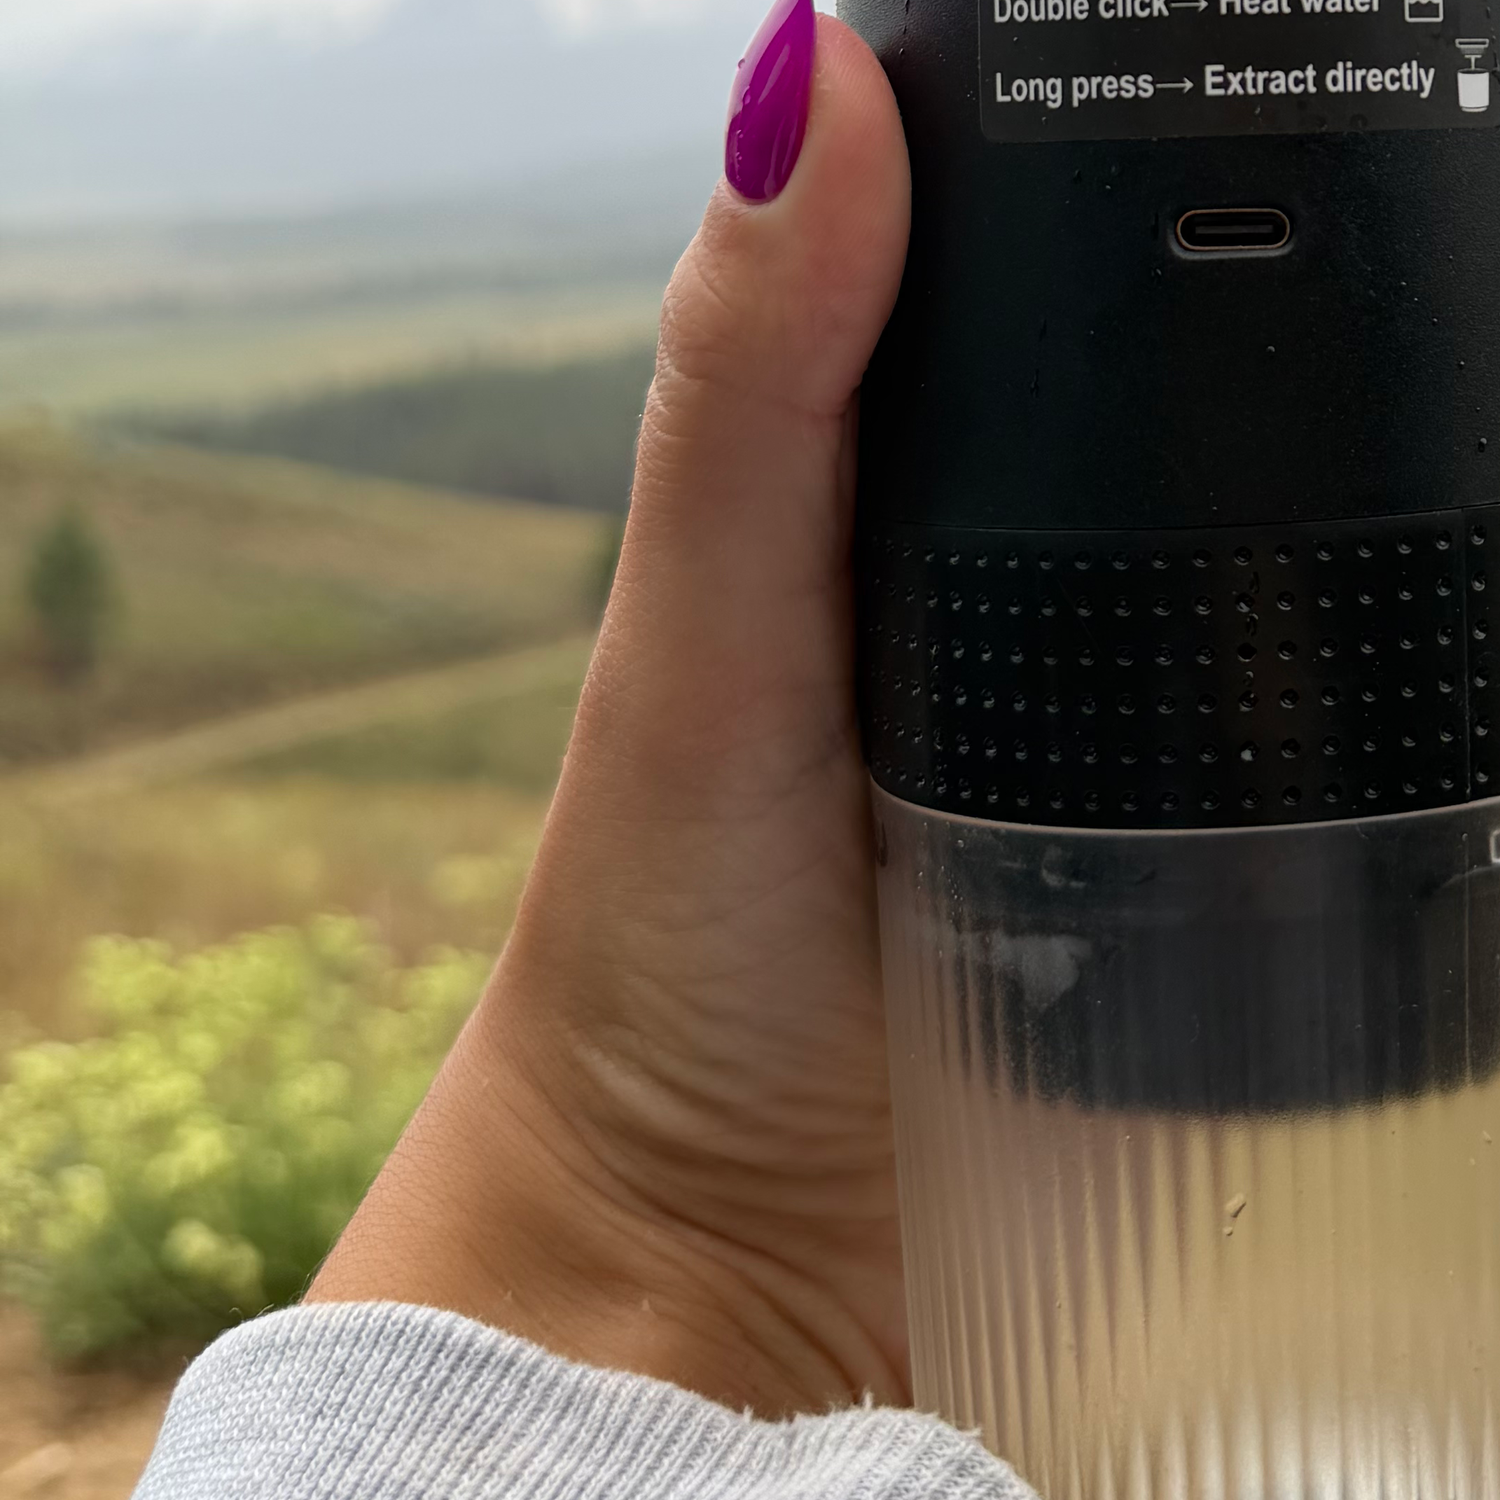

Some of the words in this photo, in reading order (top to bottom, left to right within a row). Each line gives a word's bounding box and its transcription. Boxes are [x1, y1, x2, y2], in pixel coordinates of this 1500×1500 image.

[995, 72, 1063, 109] Long
[1072, 74, 1155, 108] press
[1204, 63, 1317, 96] Extract
[1325, 59, 1436, 99] directly
